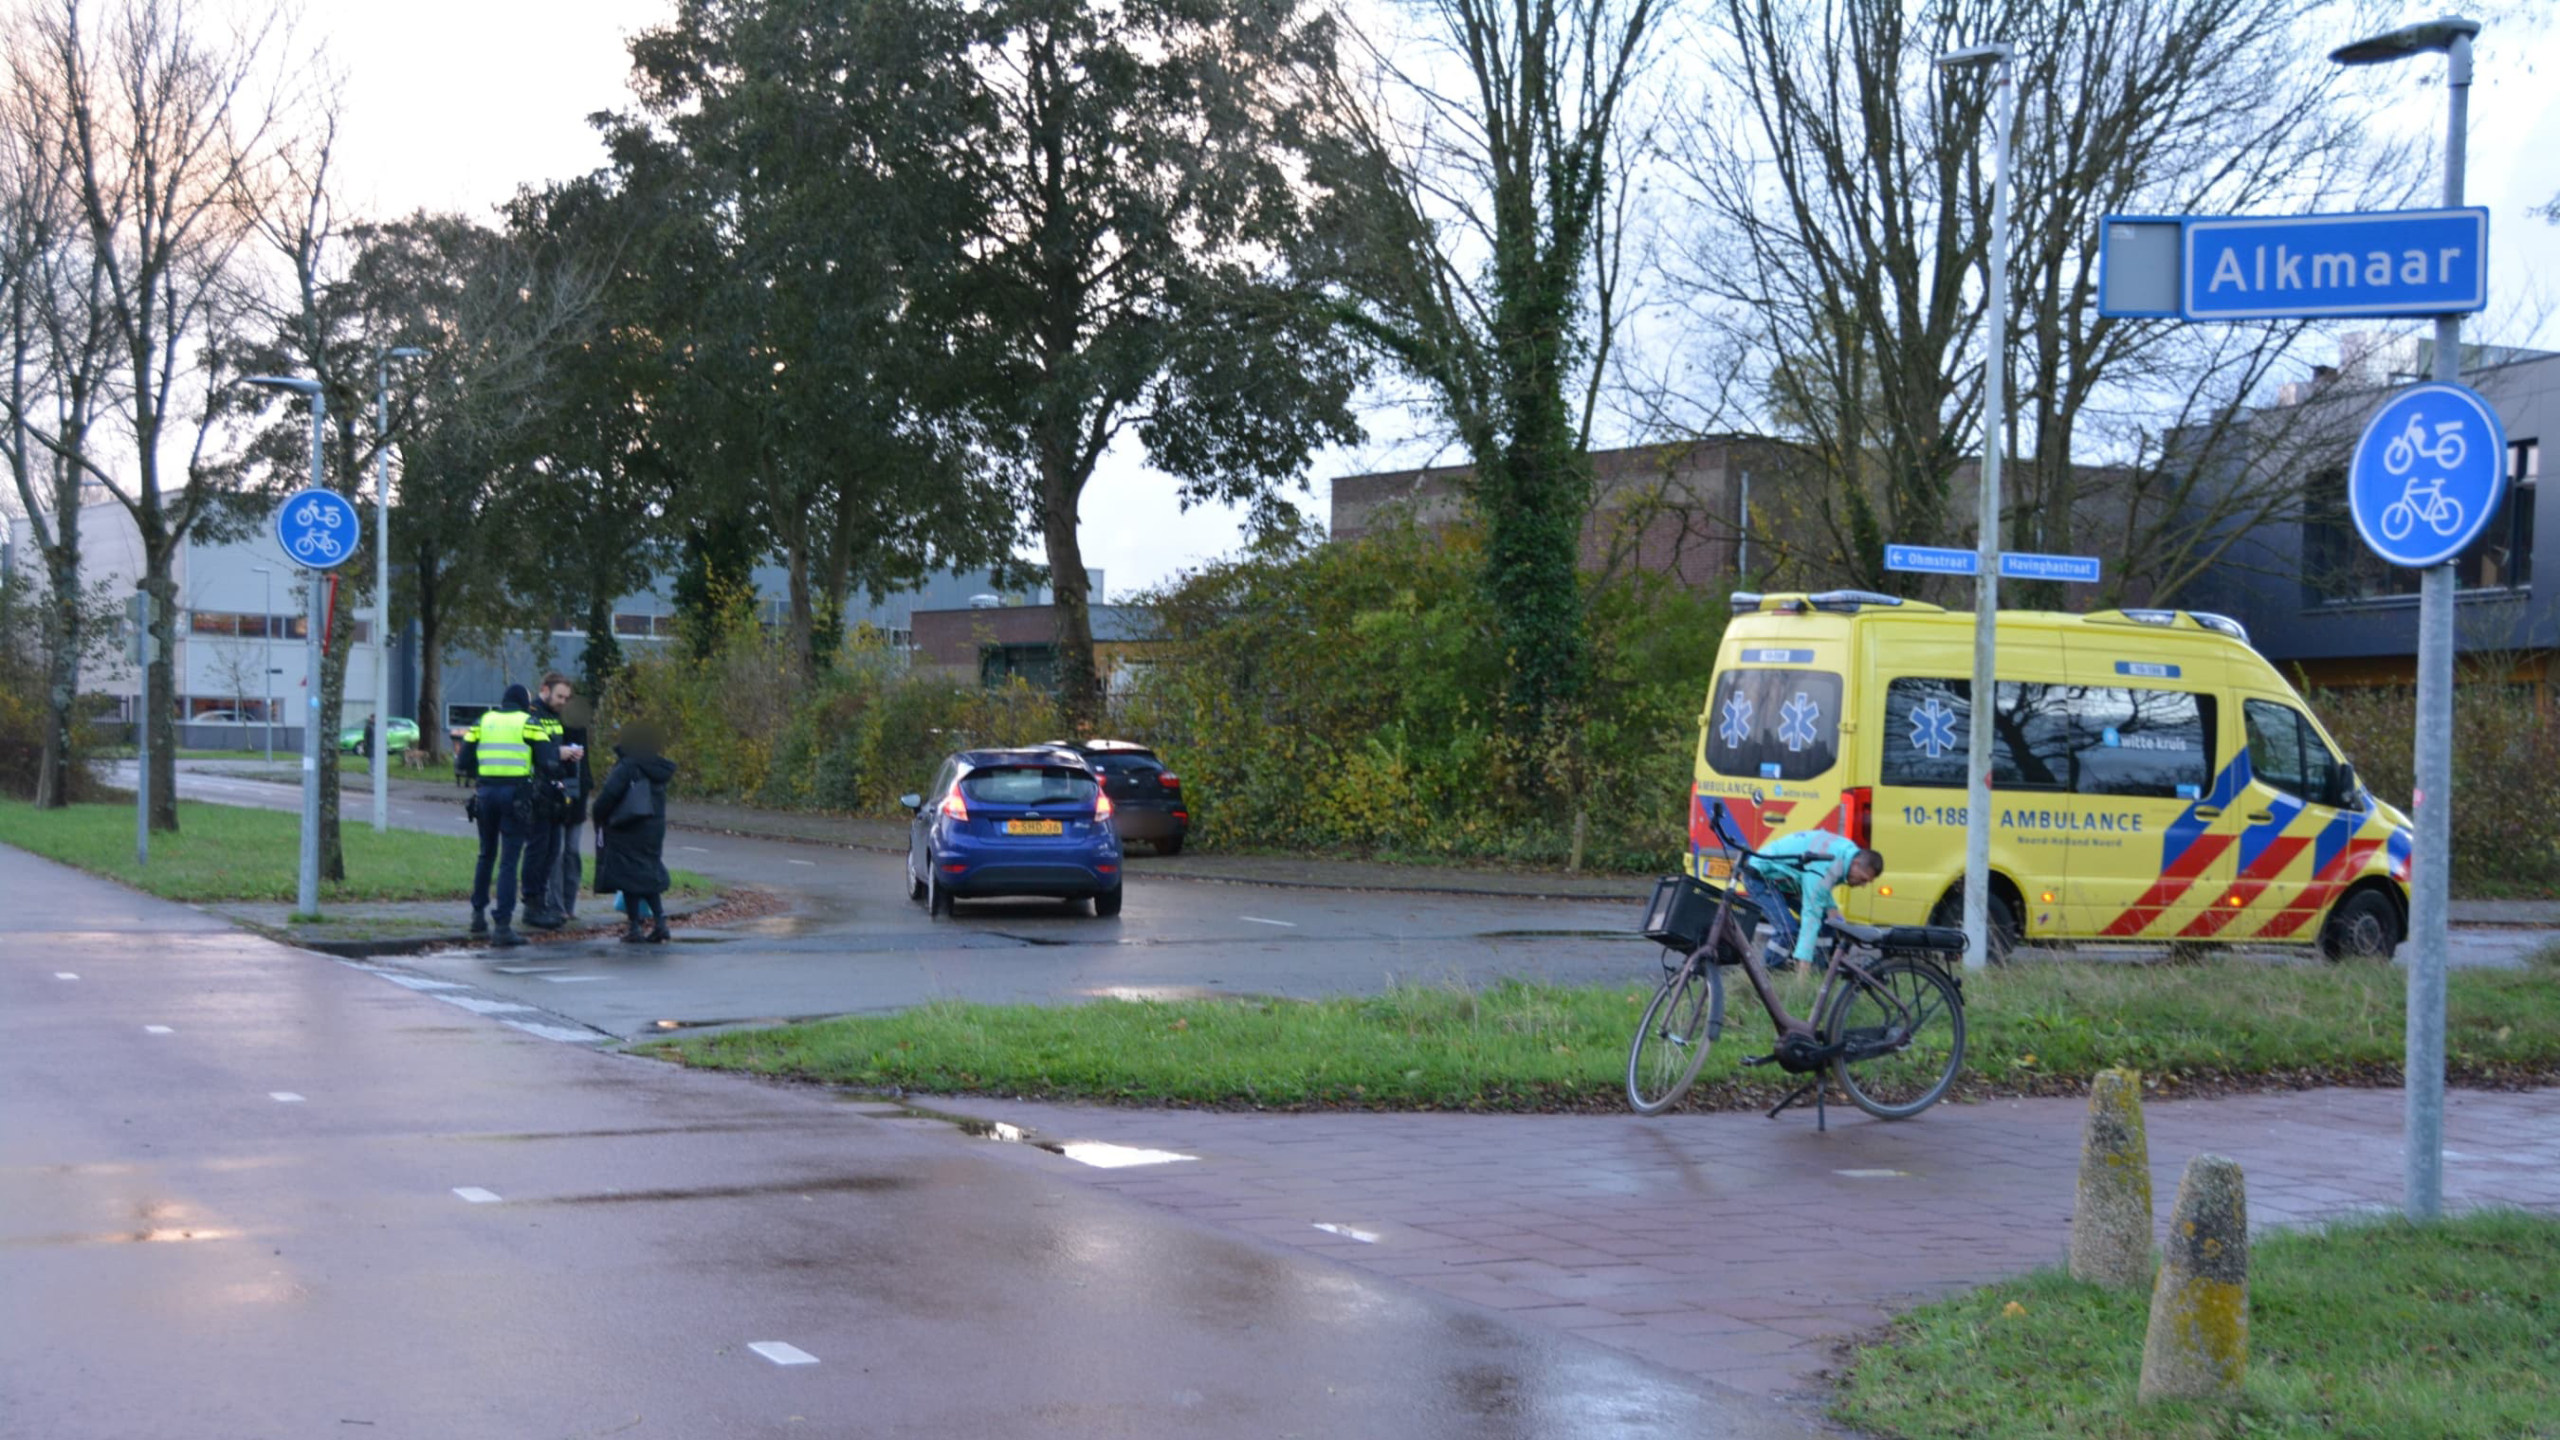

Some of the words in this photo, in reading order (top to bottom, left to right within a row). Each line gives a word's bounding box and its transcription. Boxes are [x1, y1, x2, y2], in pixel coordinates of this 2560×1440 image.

[2209, 244, 2461, 293] Alkmaar
[1908, 551, 1968, 569] Ohmstraat
[2009, 557, 2091, 575] Havinghastraat
[2121, 735, 2155, 749] witte
[2156, 736, 2187, 751] kruis
[1697, 780, 1755, 795] AMBULANCE
[1902, 806, 1969, 826] 10-188
[2000, 809, 2143, 832] AMBULANCE
